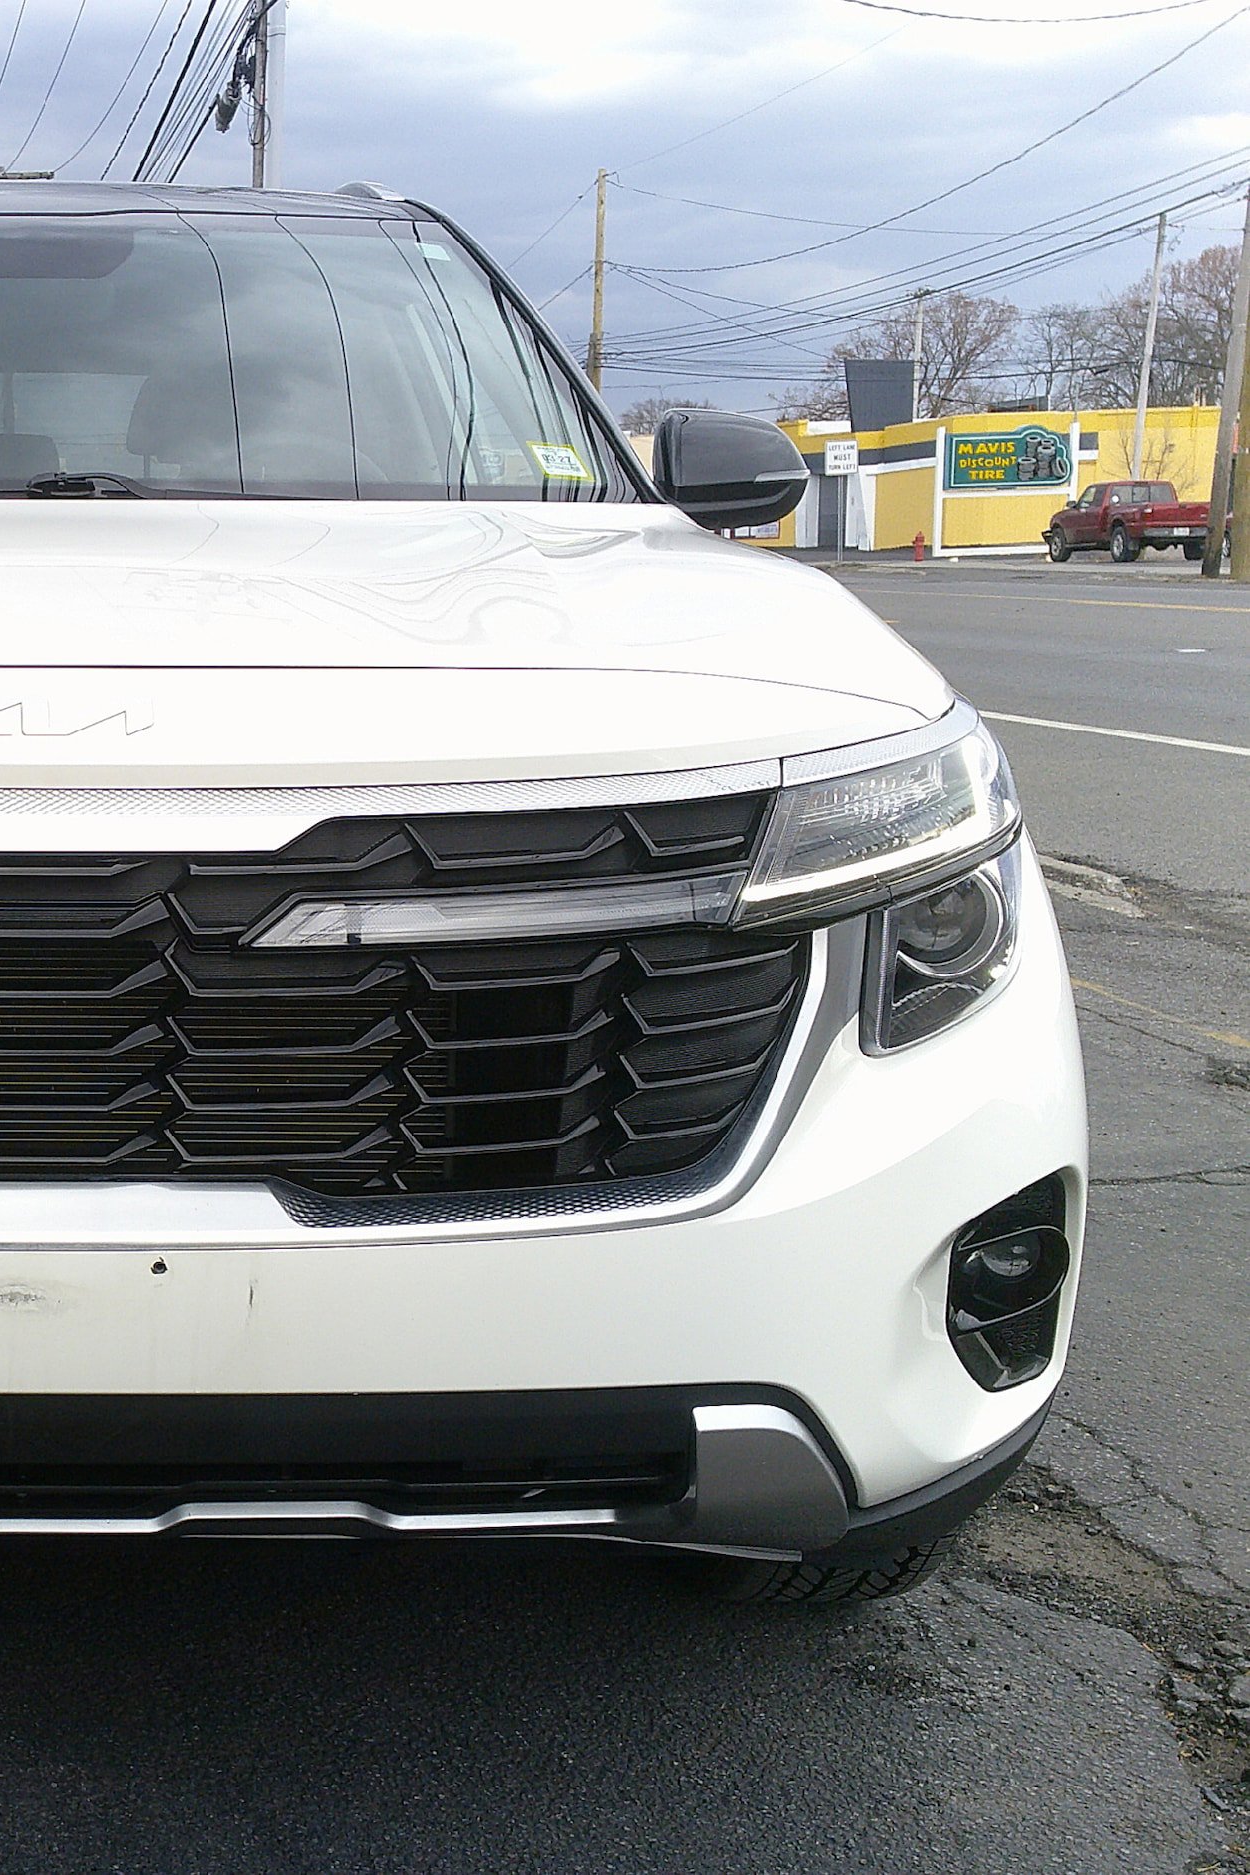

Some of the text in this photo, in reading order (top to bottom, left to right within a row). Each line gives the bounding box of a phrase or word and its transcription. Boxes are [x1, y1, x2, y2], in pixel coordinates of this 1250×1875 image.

[958, 441, 1016, 455] MAVIS
[834, 453, 851, 461] MUST
[959, 456, 1017, 469] DISCOUNT
[969, 469, 1005, 480] TIRE
